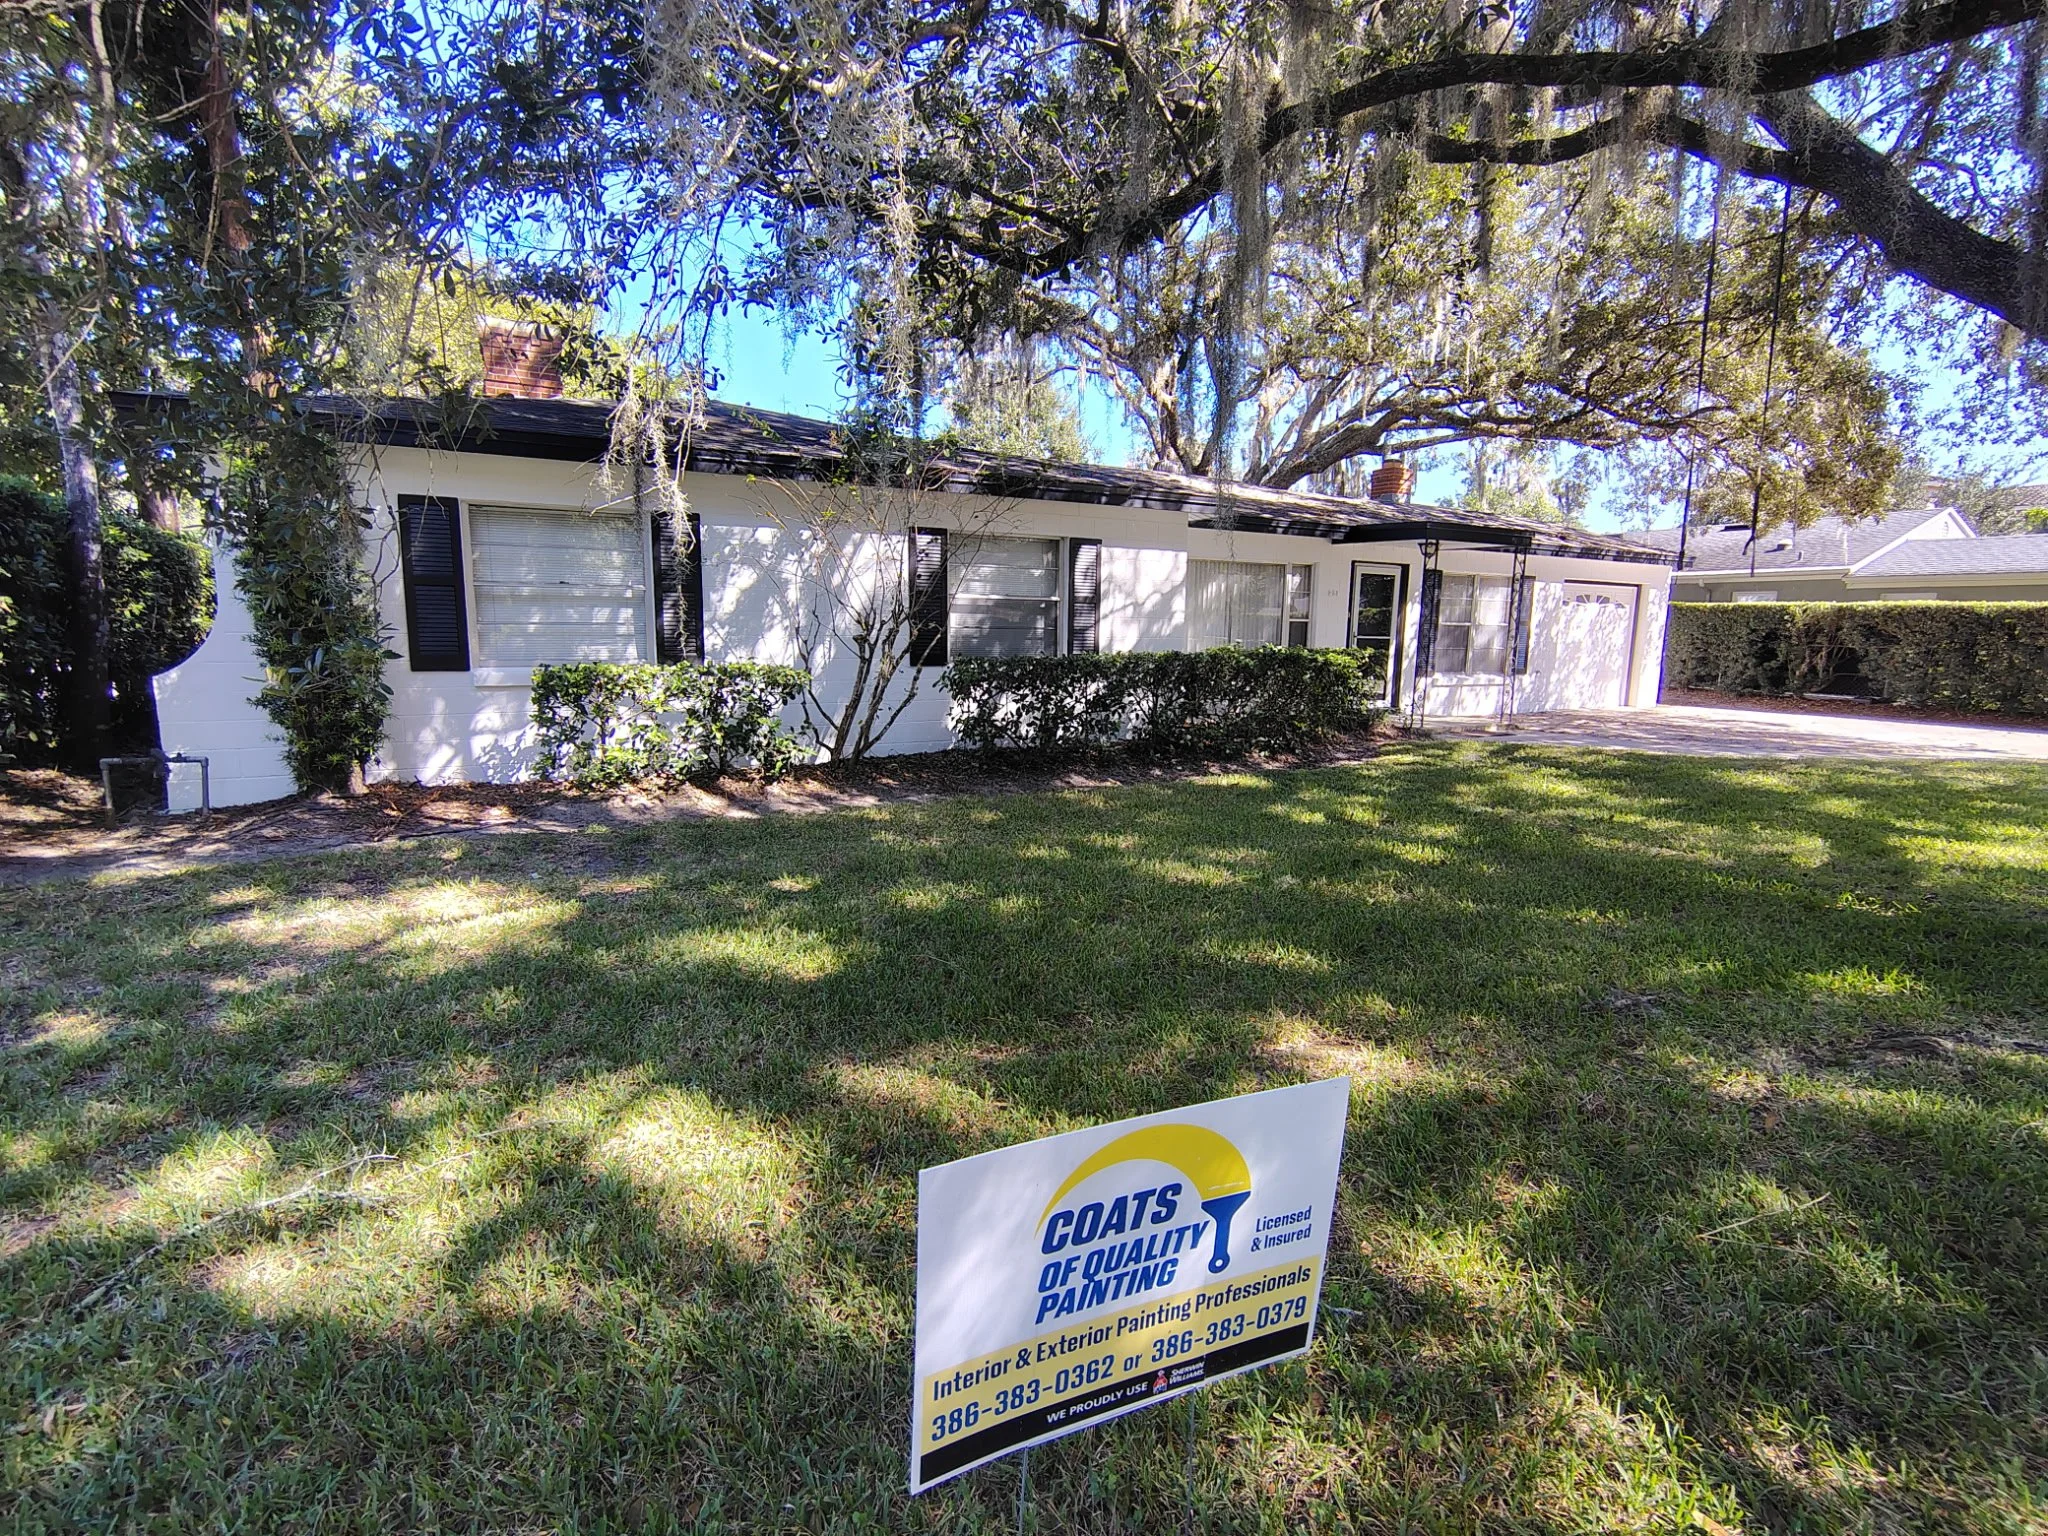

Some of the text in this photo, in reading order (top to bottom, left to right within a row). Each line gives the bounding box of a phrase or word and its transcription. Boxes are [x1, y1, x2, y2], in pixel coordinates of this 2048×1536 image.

[1041, 1182, 1183, 1255] COATS
[1250, 1223, 1312, 1252] & Insured
[1256, 1205, 1312, 1233] Licensed
[1034, 1257, 1180, 1325] PAINTING
[1037, 1220, 1211, 1293] OF QUALITY
[933, 1265, 1311, 1401] Interior & Exterior Painting Professionals
[931, 1295, 1307, 1442] 386-383-0362 or 386-383-0379
[1046, 1381, 1149, 1423] WE PROUDLY USE
